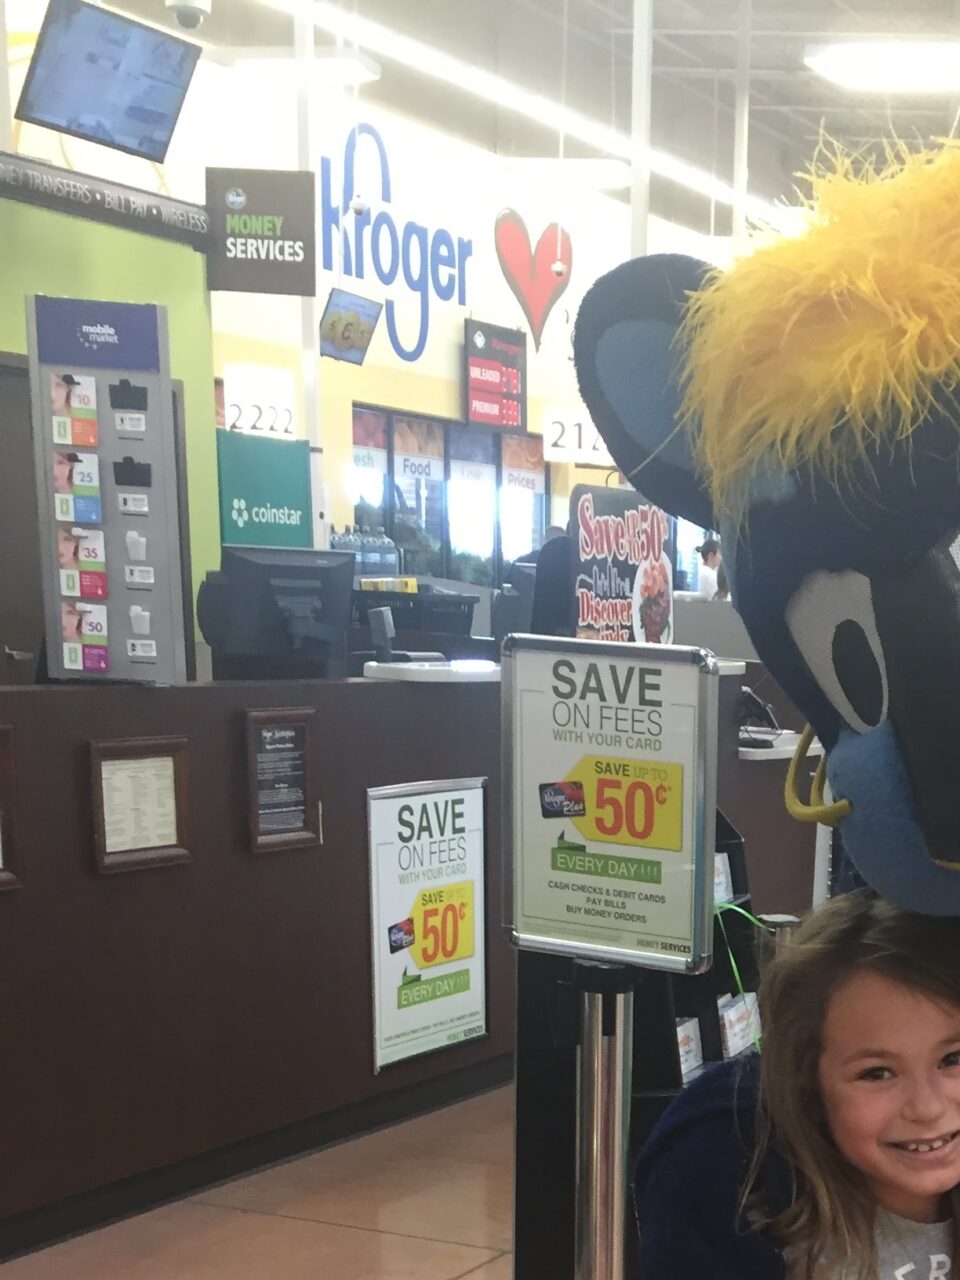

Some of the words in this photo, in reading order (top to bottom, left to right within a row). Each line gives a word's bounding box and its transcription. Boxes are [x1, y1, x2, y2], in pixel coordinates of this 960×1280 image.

[26, 169, 91, 203] TRANSFERS
[104, 190, 127, 213] BILL
[130, 197, 148, 217] PAY
[160, 205, 207, 233] WIRELESS
[226, 213, 284, 236] MONEY
[225, 237, 304, 262] SERVICES
[321, 122, 472, 362] Kroger
[82, 325, 115, 335] mobile
[89, 334, 118, 344] market
[230, 403, 293, 434] 2222
[353, 451, 374, 469] esh
[403, 458, 431, 477] Food
[507, 472, 536, 490] Prices
[252, 503, 302, 525] coinstar
[578, 493, 626, 561] Save
[578, 589, 633, 627] Discover
[552, 659, 663, 708] SAVE
[552, 700, 590, 729] ON
[599, 705, 663, 737] FEES
[553, 729, 583, 744] WITH
[587, 734, 622, 747] YOUR
[626, 736, 662, 752] CARD
[594, 761, 631, 777] SAVE
[397, 798, 466, 844] SAVE
[398, 844, 424, 871] ON
[429, 836, 467, 866] FEES
[557, 854, 605, 874] EVERY
[398, 871, 420, 884] WITH
[422, 867, 443, 880] YOUR
[444, 863, 467, 876] CARD
[422, 891, 444, 906] SAVE
[548, 881, 569, 891] CASH
[571, 884, 603, 896] CHECKS
[612, 889, 636, 900] DEBIT
[637, 892, 666, 904] CARDS
[586, 897, 602, 906] PAY
[604, 899, 627, 910] BILLS
[566, 905, 582, 914] BUY
[584, 907, 612, 918] MONEY
[614, 911, 648, 924] ORDERS
[660, 942, 692, 954] SERVICES
[401, 984, 434, 1005] EVERY
